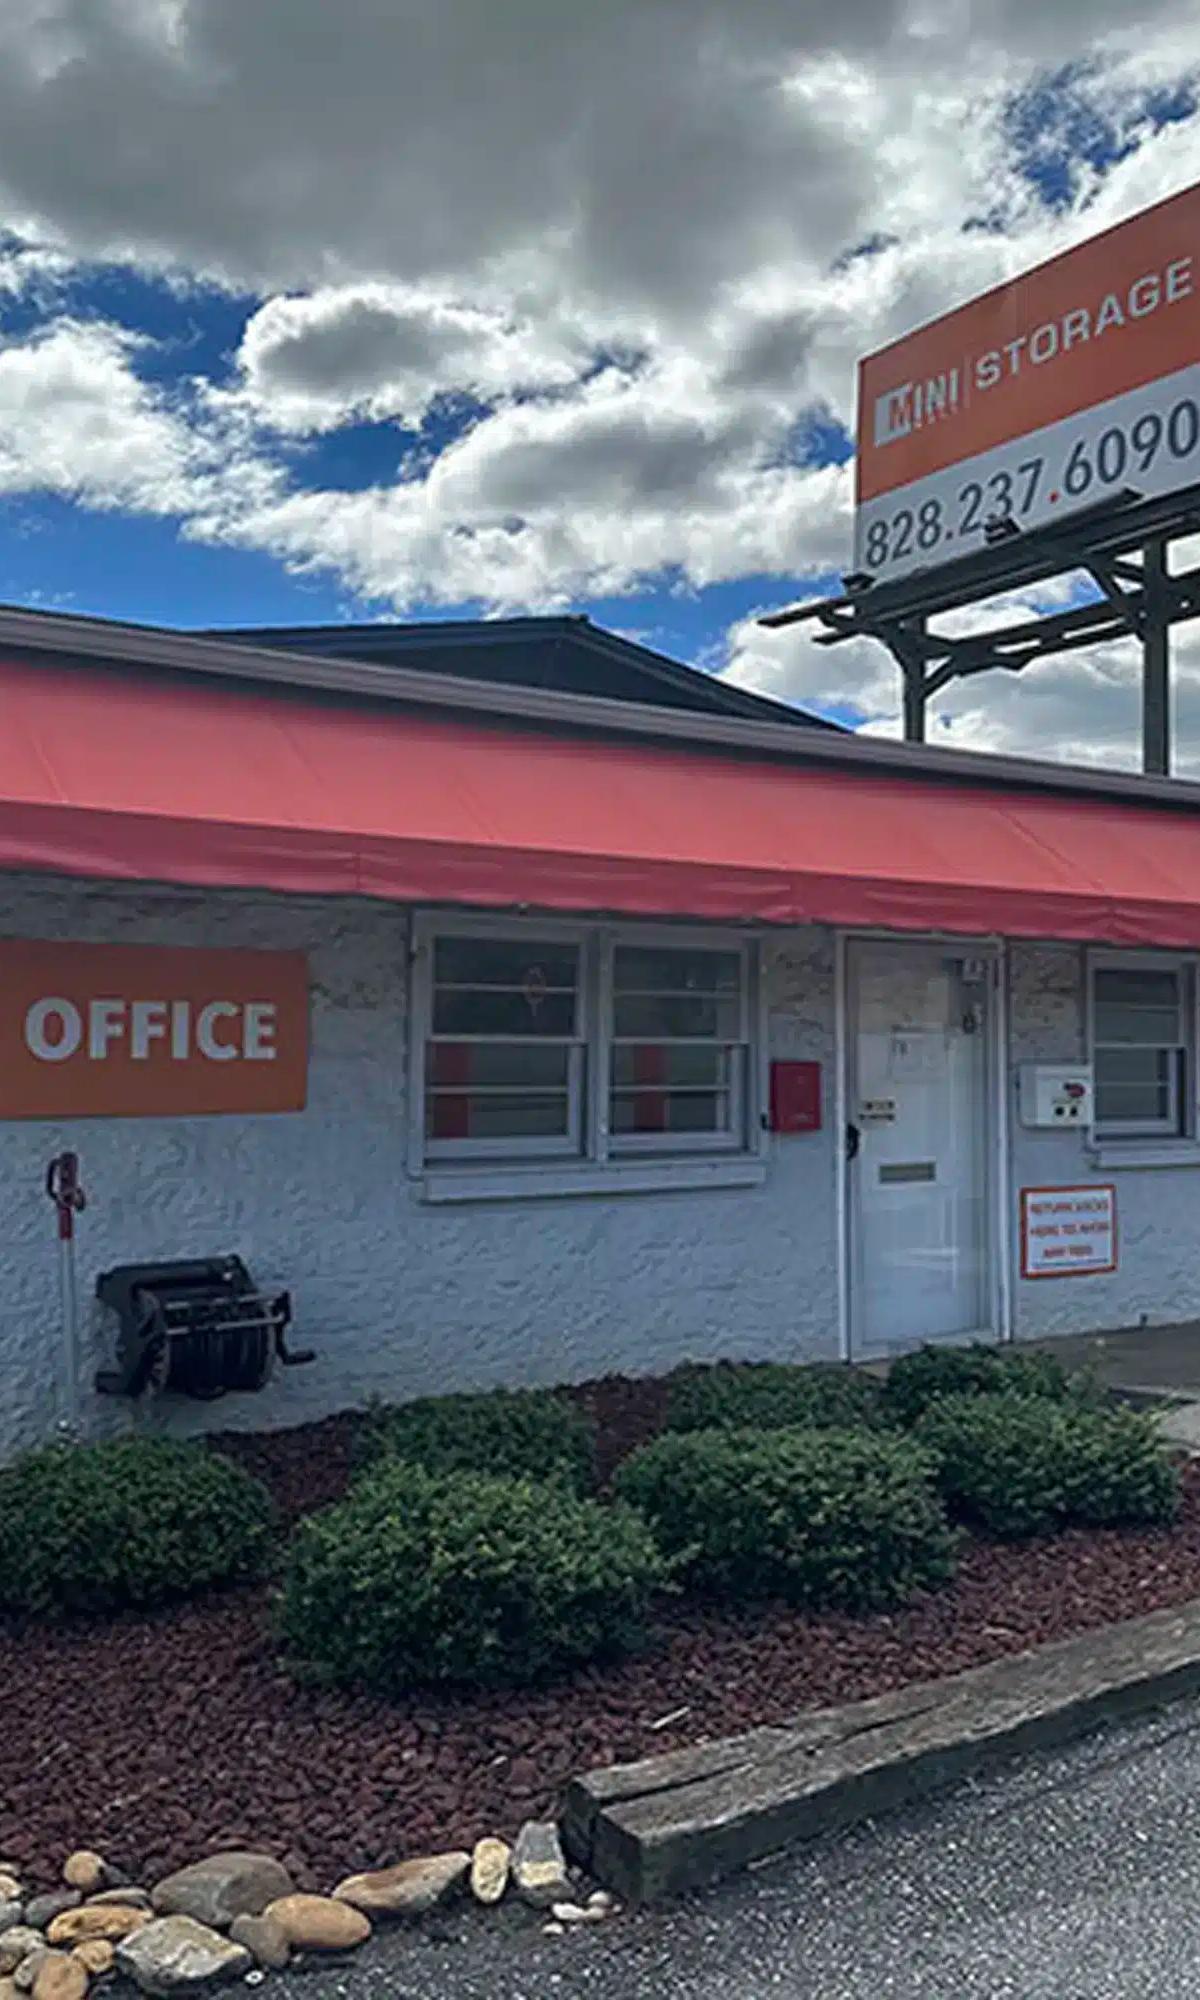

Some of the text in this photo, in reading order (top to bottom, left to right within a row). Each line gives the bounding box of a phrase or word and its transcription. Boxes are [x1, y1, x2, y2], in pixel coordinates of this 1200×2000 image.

[875, 257, 1194, 447] MINI STORAGE
[866, 399, 1200, 568] 828.237.6090
[25, 997, 277, 1060] OFFICE
